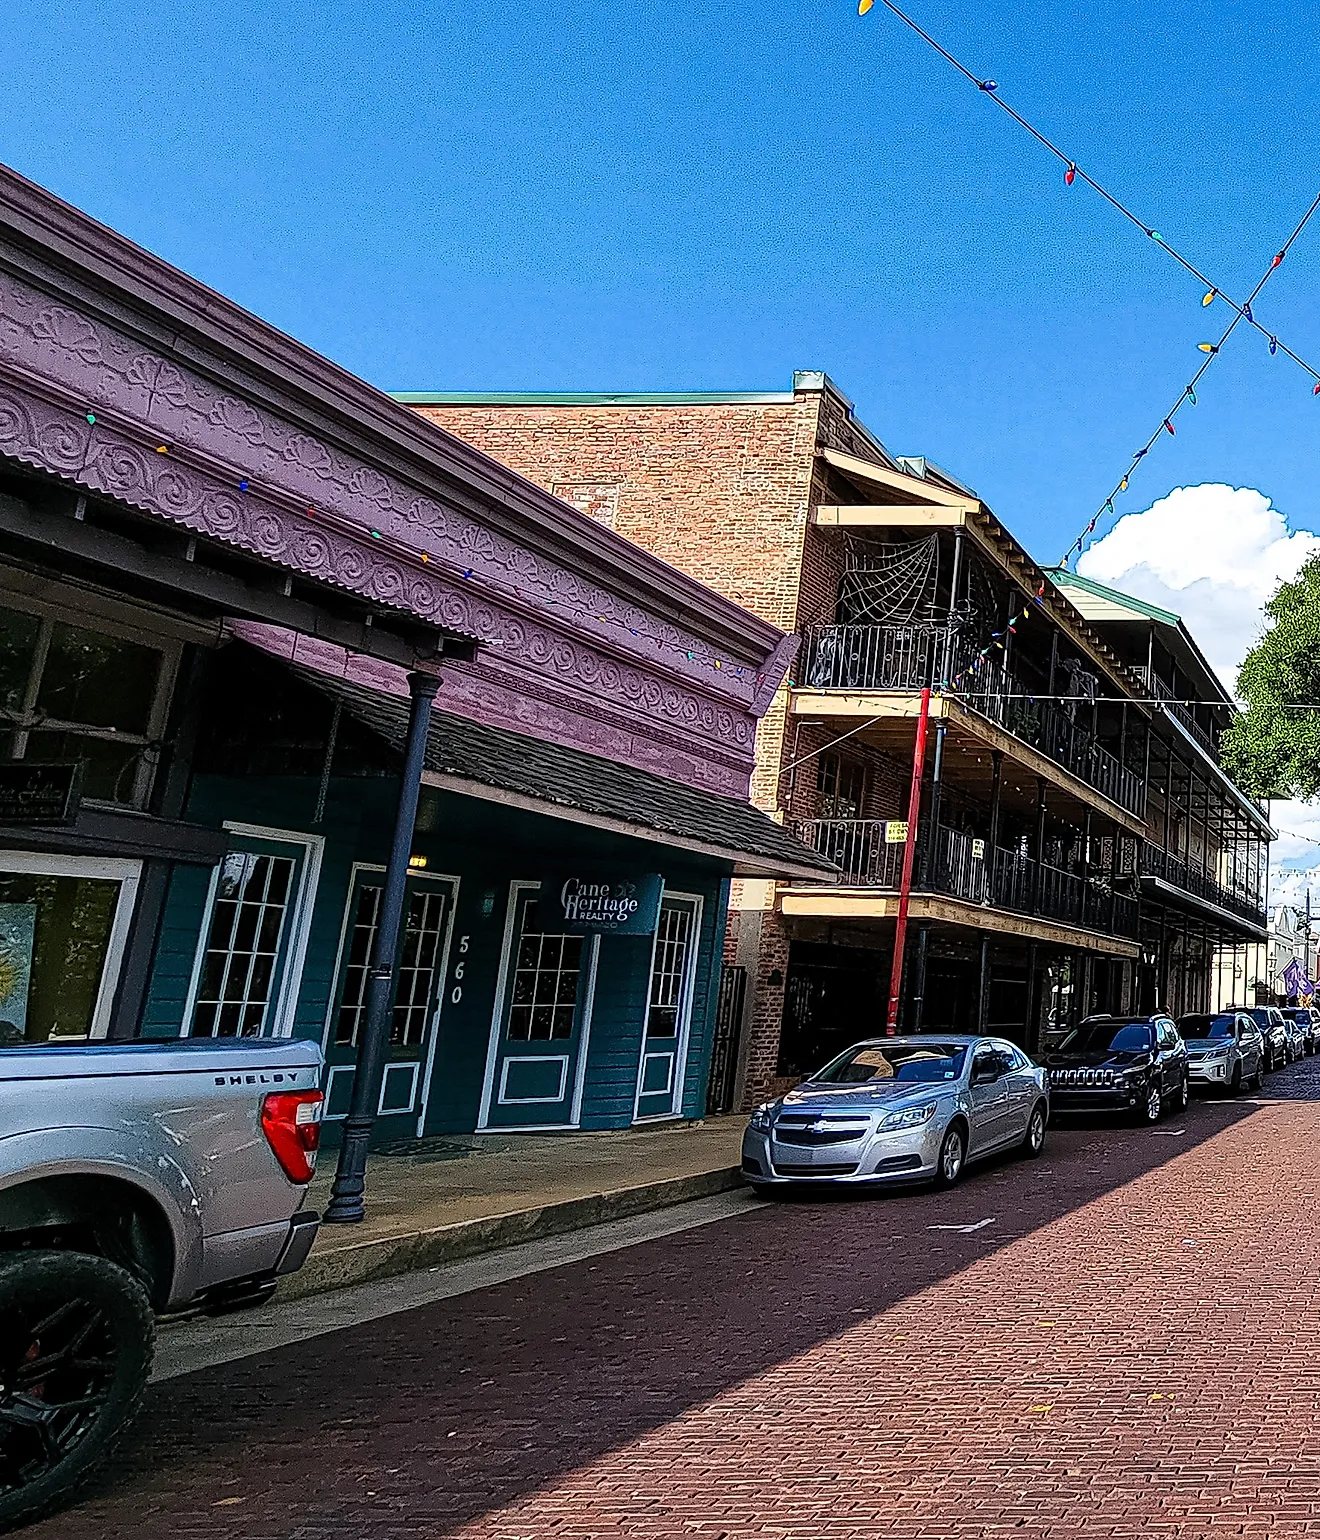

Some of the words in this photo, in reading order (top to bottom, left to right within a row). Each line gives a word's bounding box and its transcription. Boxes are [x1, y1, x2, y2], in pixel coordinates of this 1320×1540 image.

[561, 878, 610, 909] Cane
[564, 894, 638, 921] Heritage
[580, 912, 615, 920] REALTY
[214, 1072, 298, 1086] SHELBY
